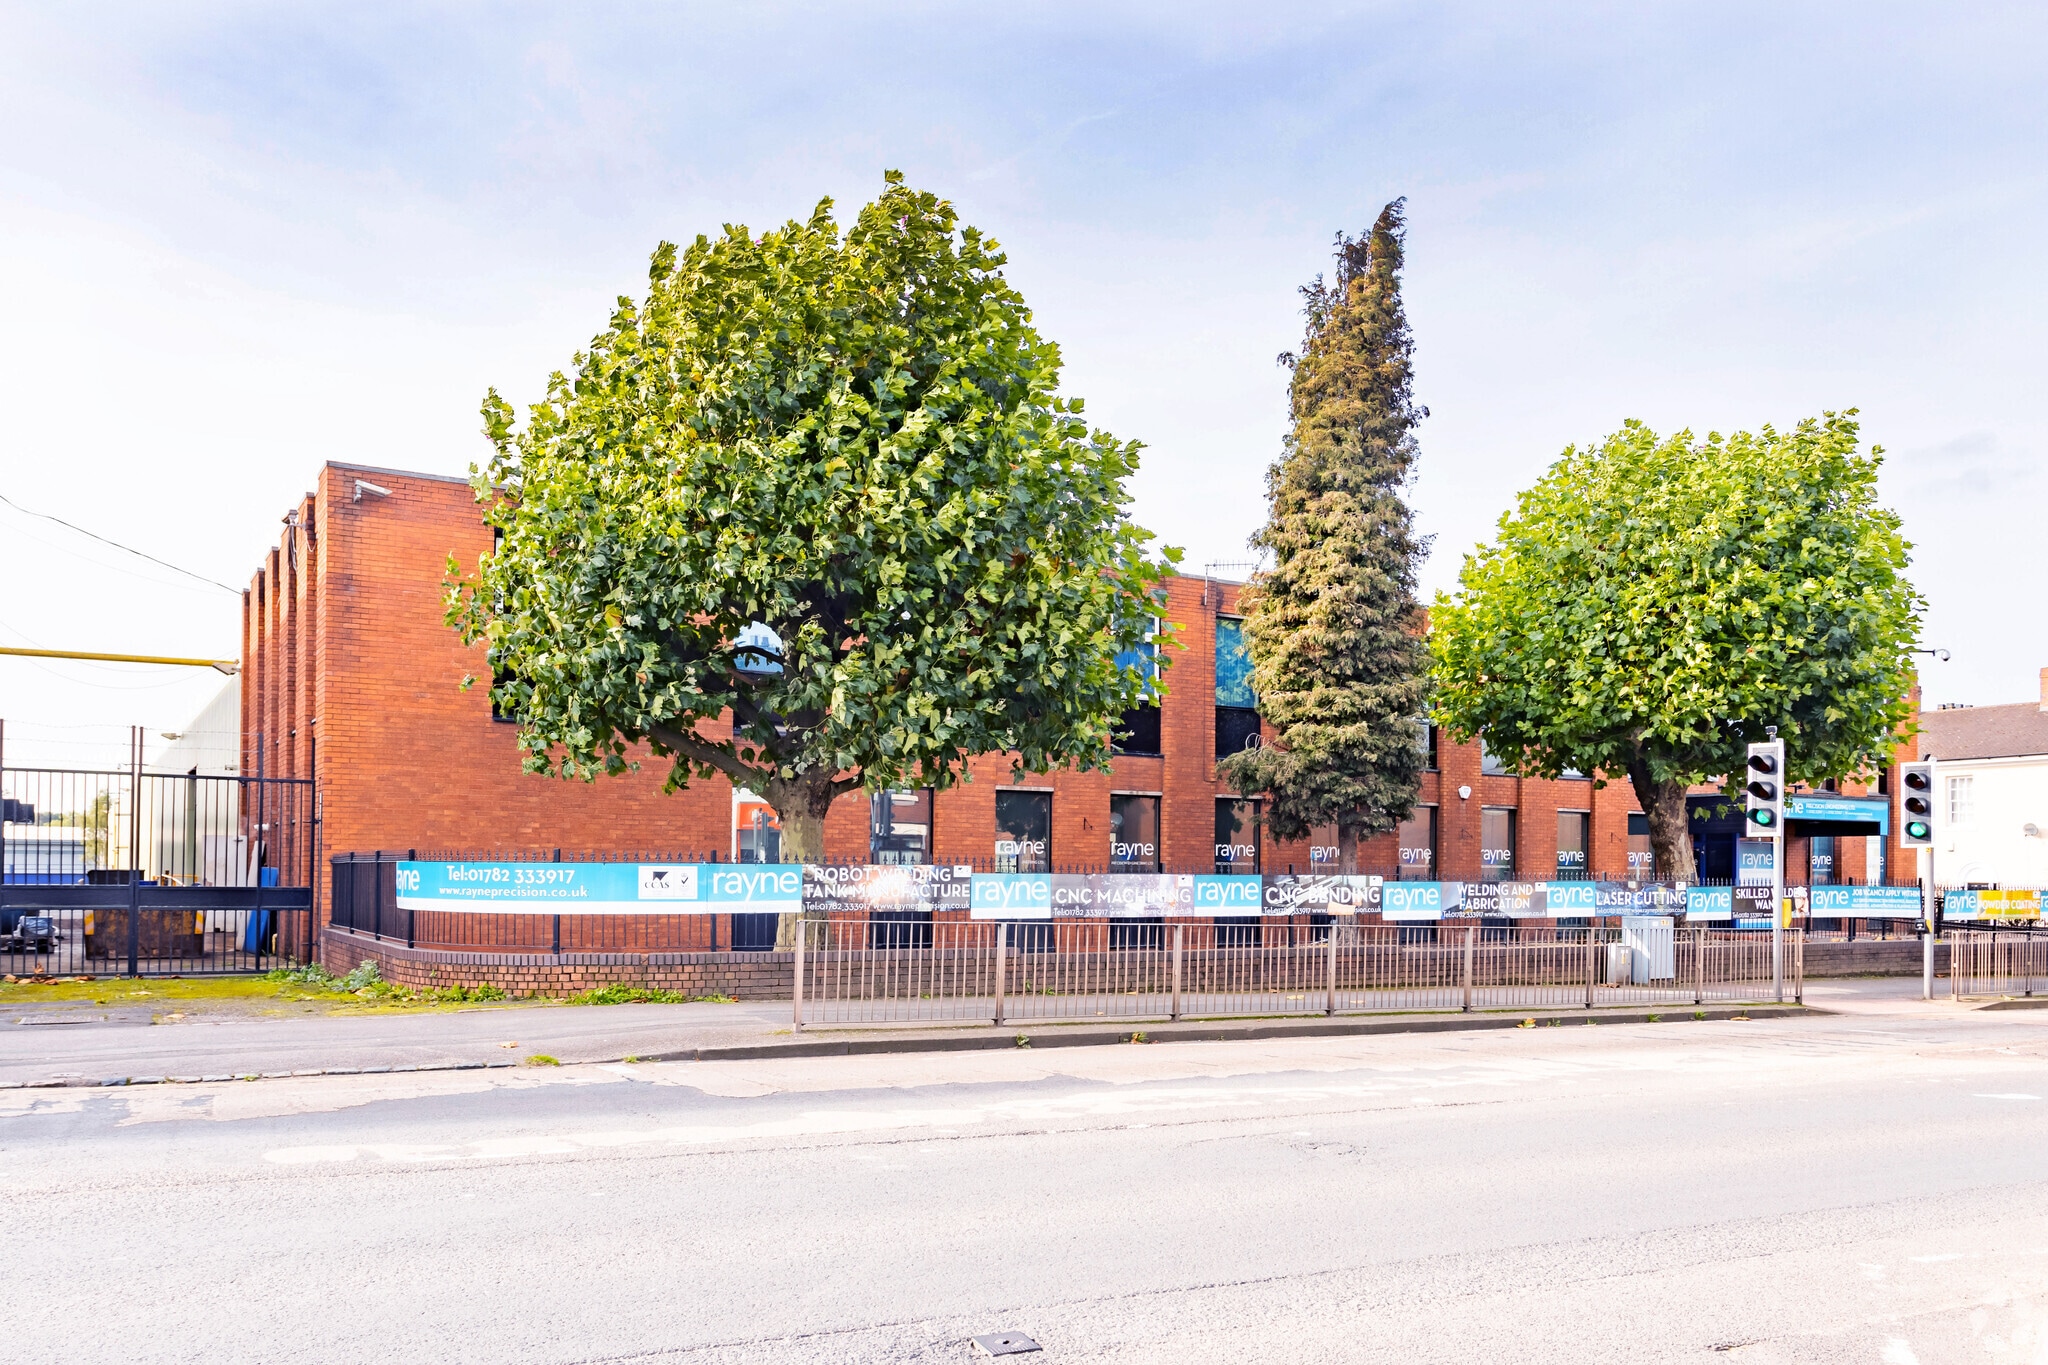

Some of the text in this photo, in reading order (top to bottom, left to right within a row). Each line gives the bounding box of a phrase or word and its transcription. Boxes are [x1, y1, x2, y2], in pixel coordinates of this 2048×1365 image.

[1111, 840, 1154, 860] rayne
[1215, 842, 1255, 861] rayne
[1309, 846, 1340, 863] rayn
[1742, 853, 1773, 868] rayne
[1812, 855, 1832, 868] ayne
[396, 869, 420, 897] ayne
[446, 865, 576, 884] Tel:01782 333917
[814, 867, 951, 882] ROBOT WELDING
[439, 885, 589, 899] www.rayneprecision.co.uk
[713, 871, 799, 901] rayne
[804, 884, 970, 898] TANK MANUFACTURE
[974, 880, 1048, 908] rayne
[1197, 881, 1259, 908] rayne
[1457, 884, 1533, 896] WELDING AND
[1735, 888, 1770, 899] SKILLED
[1055, 887, 1191, 904] CNC MACHINING
[1265, 886, 1381, 904] CNC BENDING
[1385, 886, 1439, 911] rayne
[1459, 897, 1530, 910] FABRICATION
[1547, 885, 1593, 910] rayne
[1596, 891, 1686, 906] LASER CUTTING
[1689, 892, 1730, 912] rayne
[1811, 889, 1849, 909] rayne
[843, 904, 872, 912] 333917
[1945, 894, 1977, 914] rayne
[1085, 909, 1108, 917] 333917
